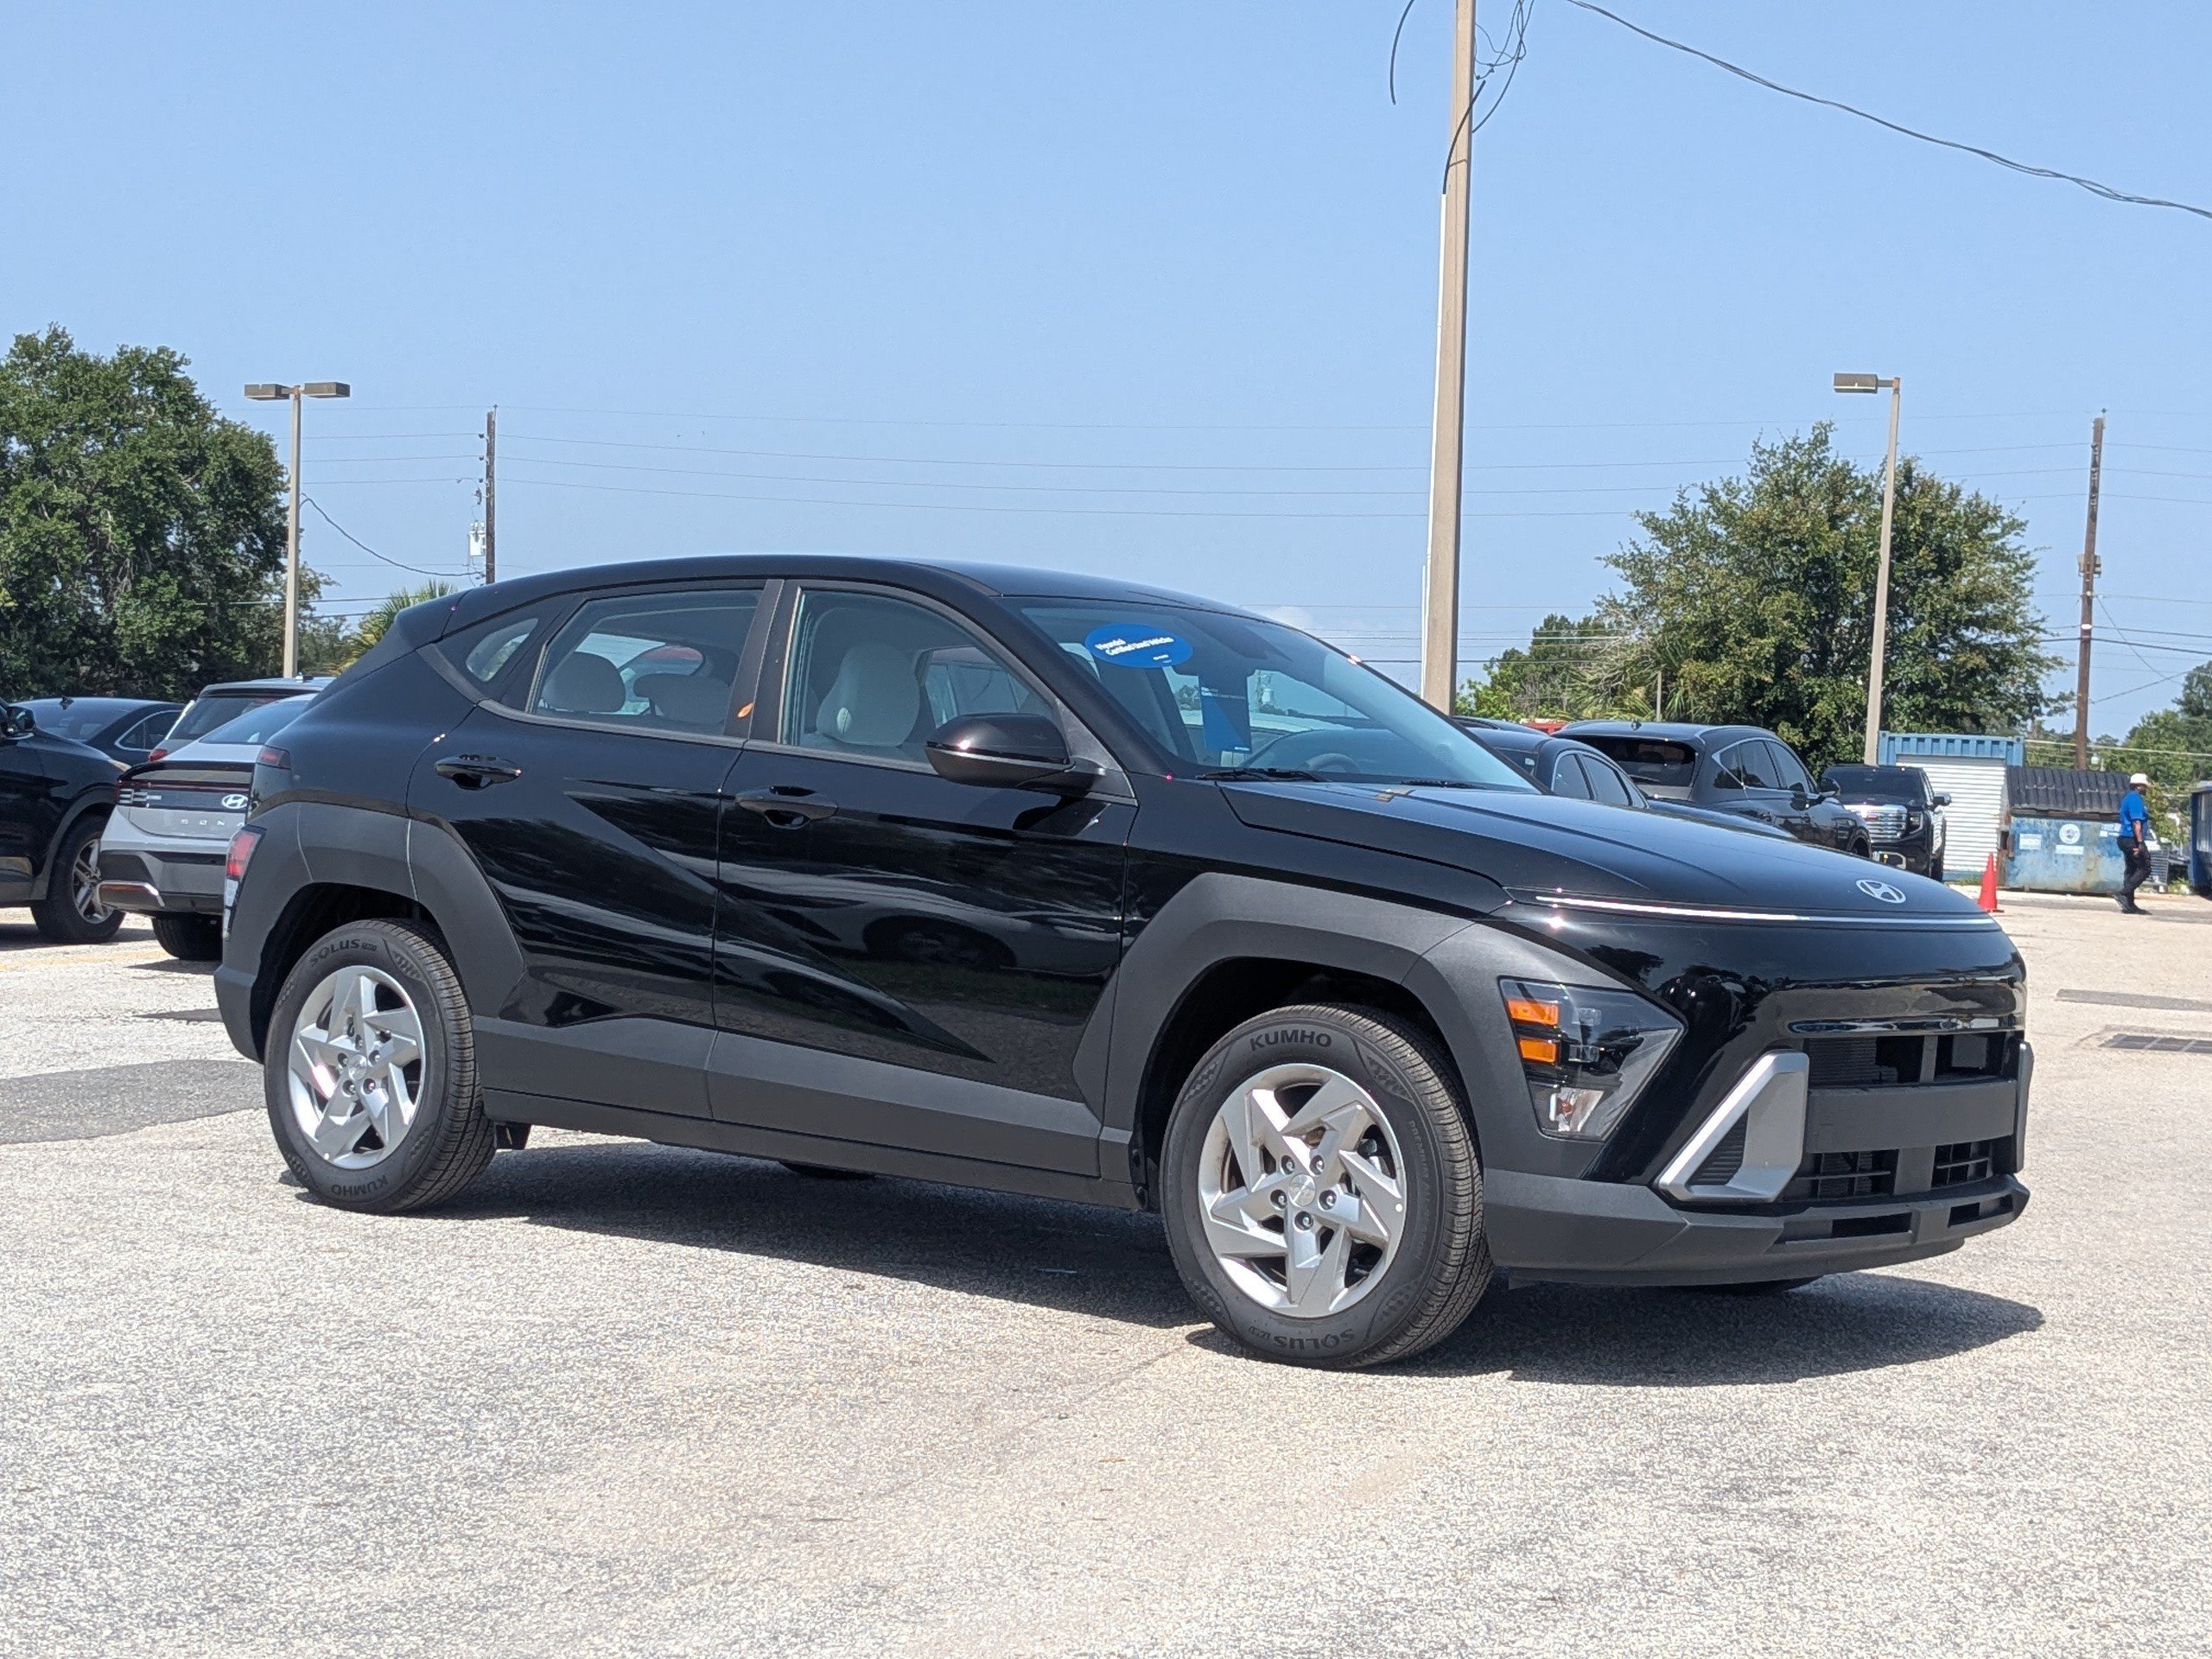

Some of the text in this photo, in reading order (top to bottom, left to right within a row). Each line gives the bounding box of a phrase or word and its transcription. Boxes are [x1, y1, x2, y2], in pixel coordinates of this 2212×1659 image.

[310, 938, 360, 967] SOLUS
[1249, 1029, 1332, 1052] KUMHO
[330, 1174, 389, 1196] KUMHO
[1273, 1328, 1355, 1350] SOLUS
